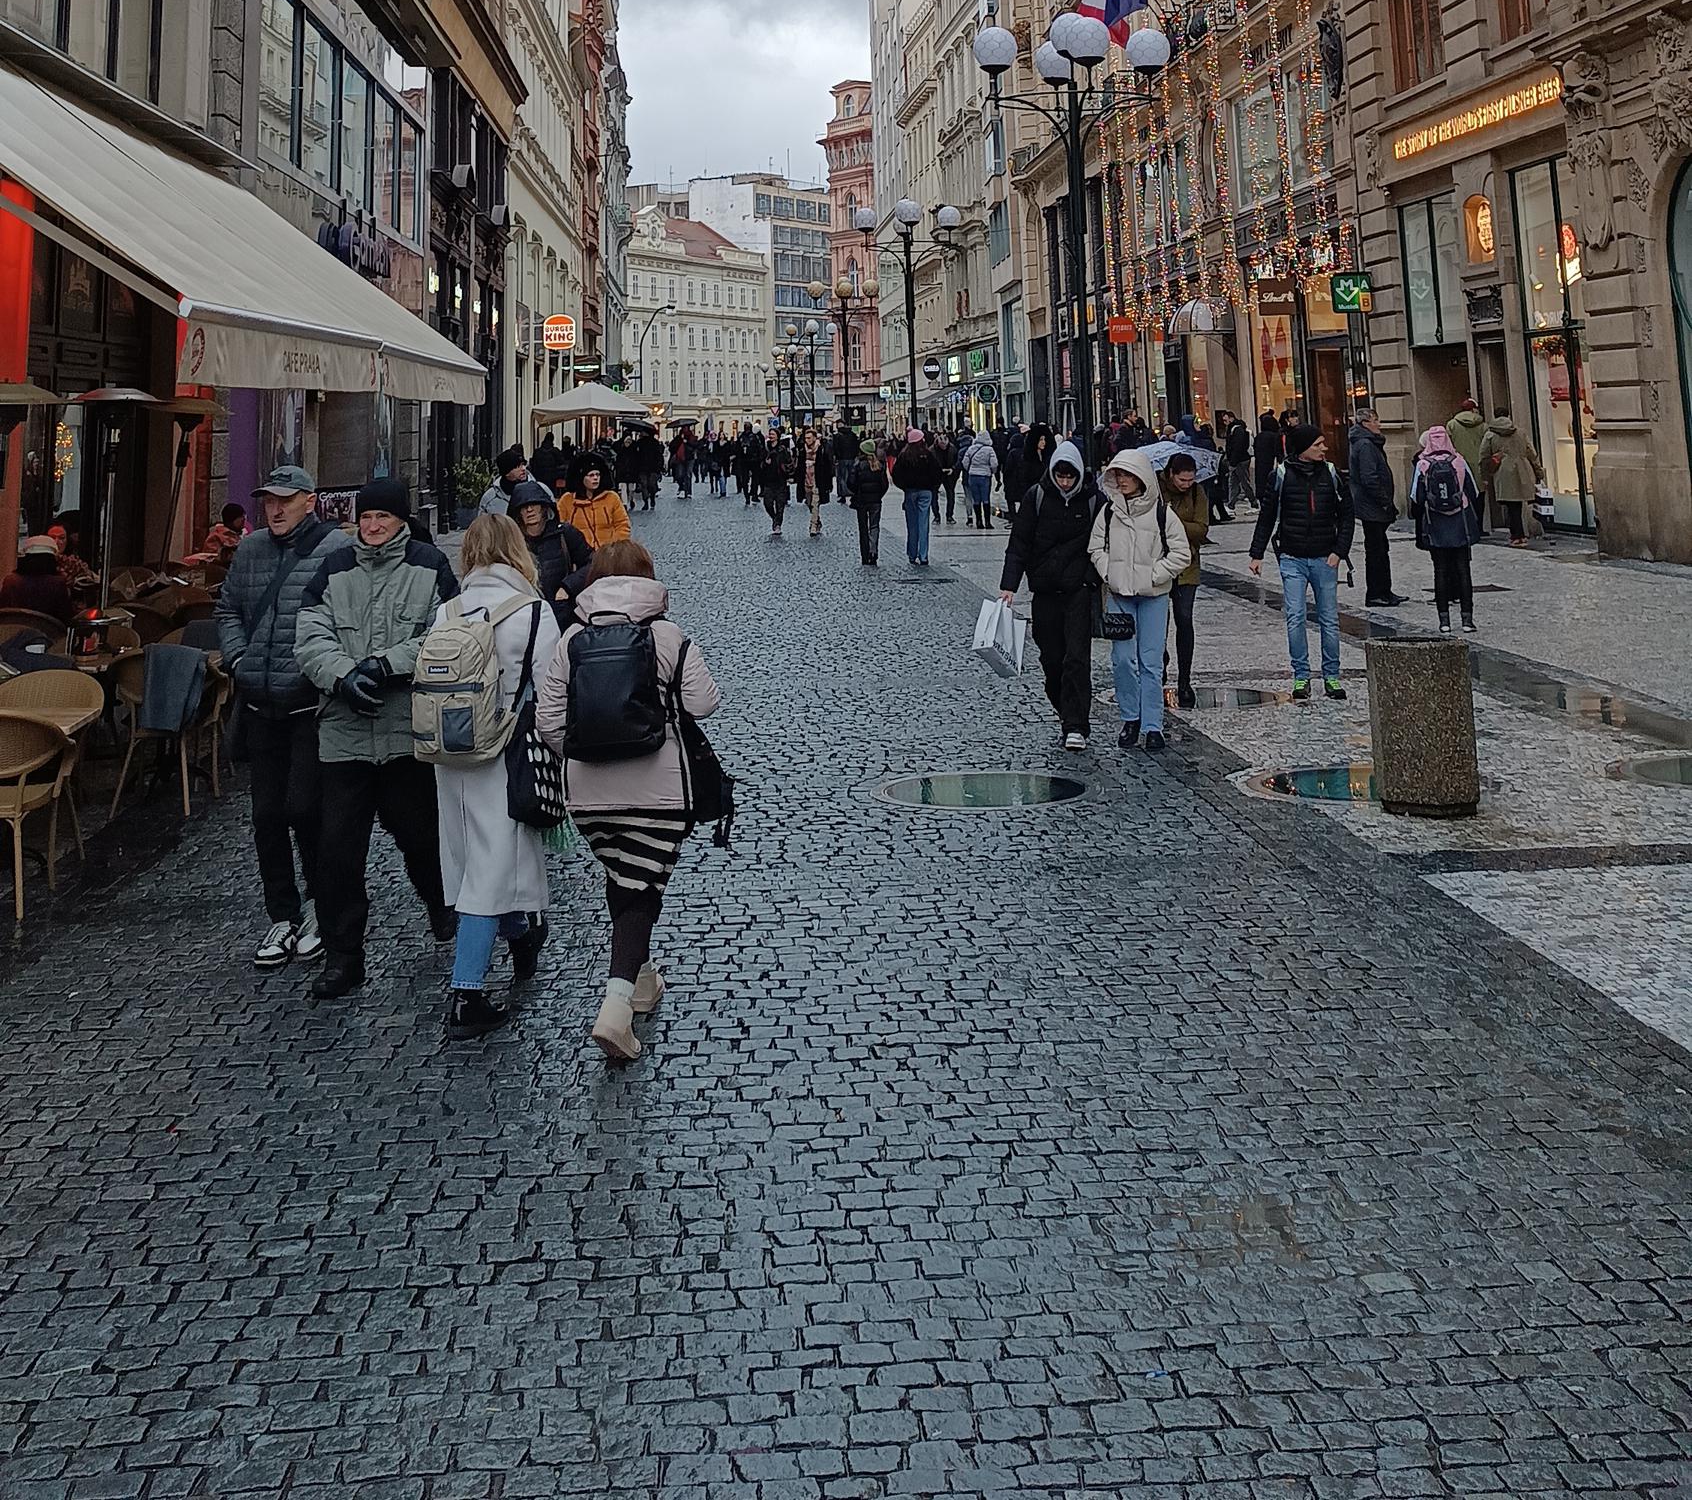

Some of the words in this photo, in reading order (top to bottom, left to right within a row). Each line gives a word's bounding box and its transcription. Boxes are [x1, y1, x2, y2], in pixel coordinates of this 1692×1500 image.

[1360, 280, 1370, 289] A
[1362, 298, 1370, 307] B
[545, 325, 574, 333] BURGER
[545, 333, 574, 342] KING
